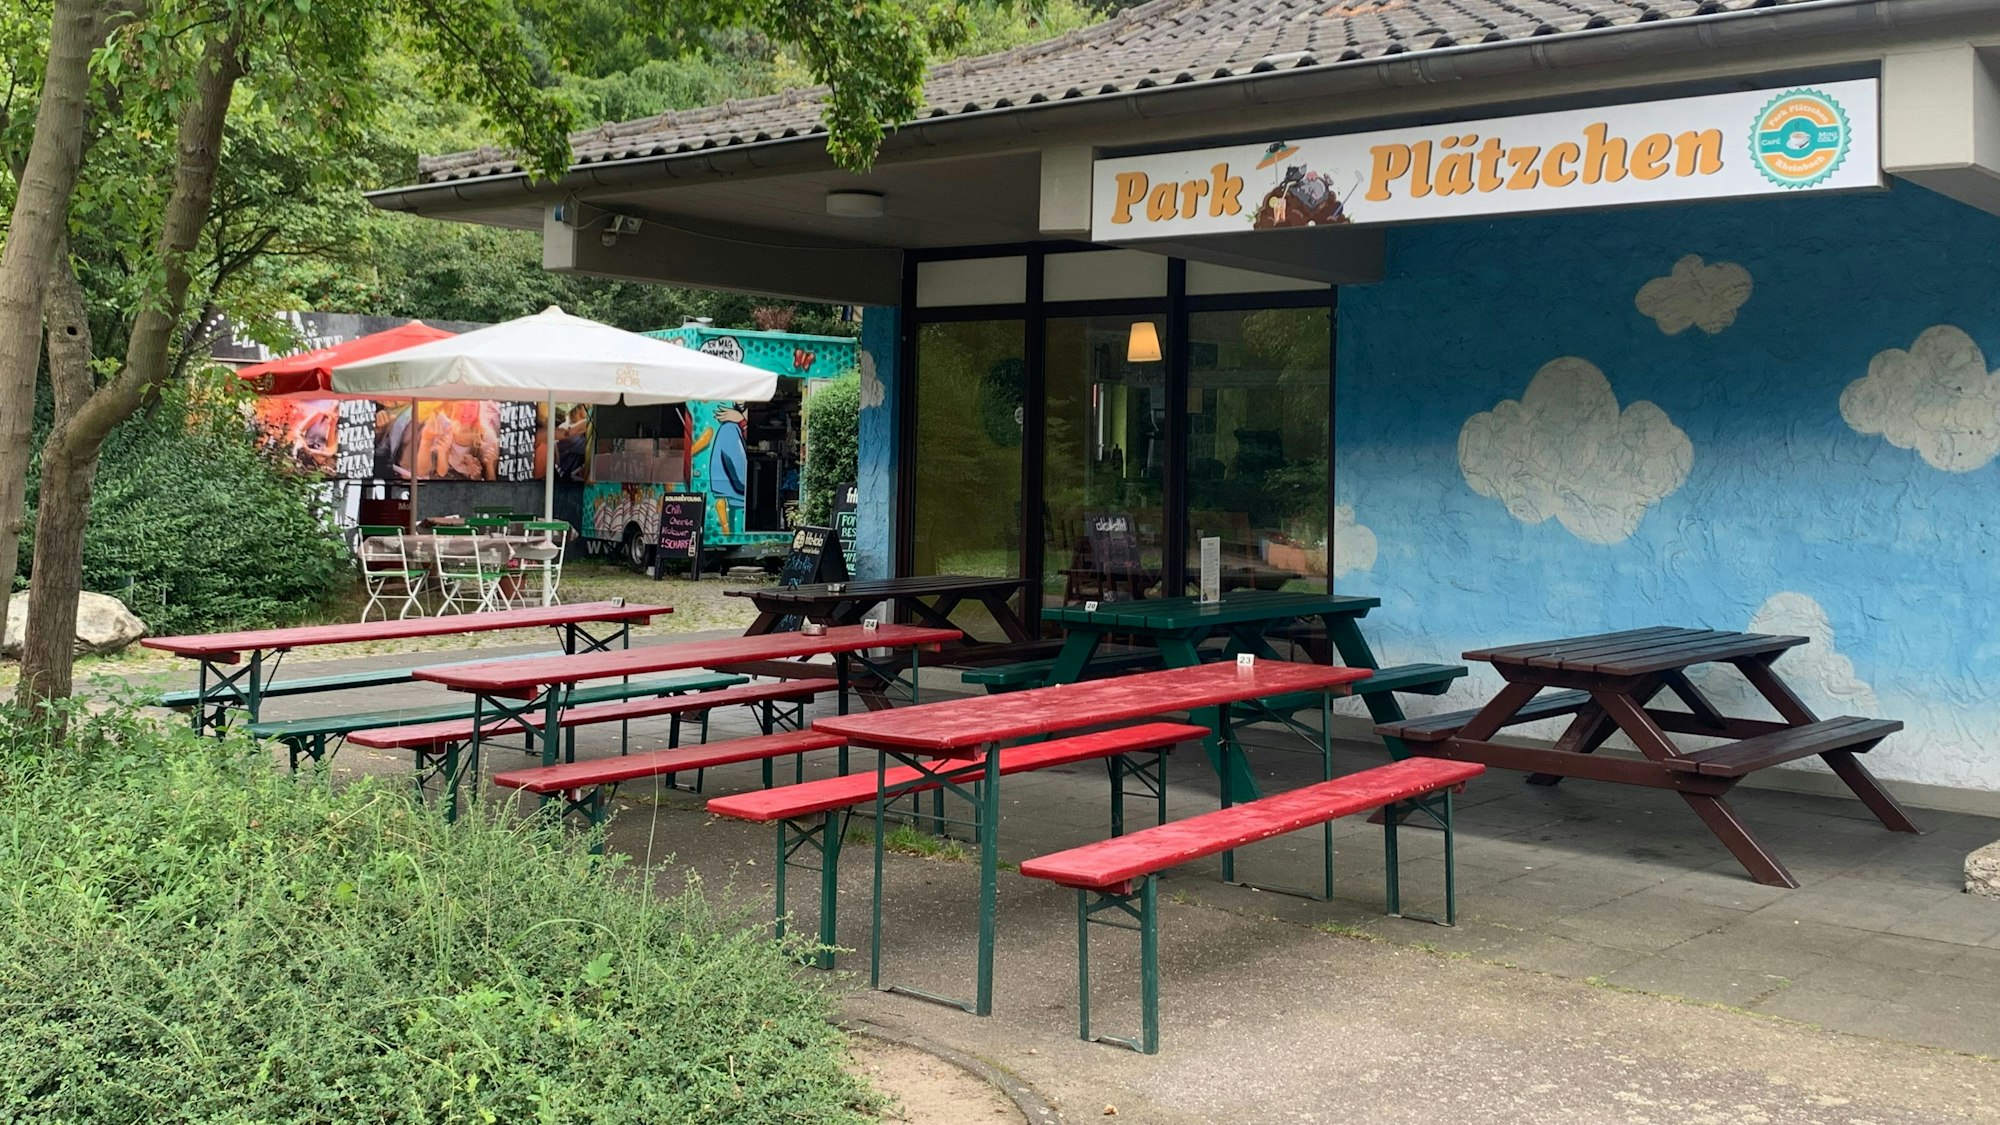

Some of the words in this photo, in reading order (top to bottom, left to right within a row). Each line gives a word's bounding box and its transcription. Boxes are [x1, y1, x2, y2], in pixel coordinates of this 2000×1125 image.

[1769, 109, 1788, 126] Park
[1775, 155, 1825, 172] Rheinbach
[1111, 162, 1244, 224] Park
[1365, 122, 1723, 201] Plätzchen
[1239, 656, 1251, 664] 23
